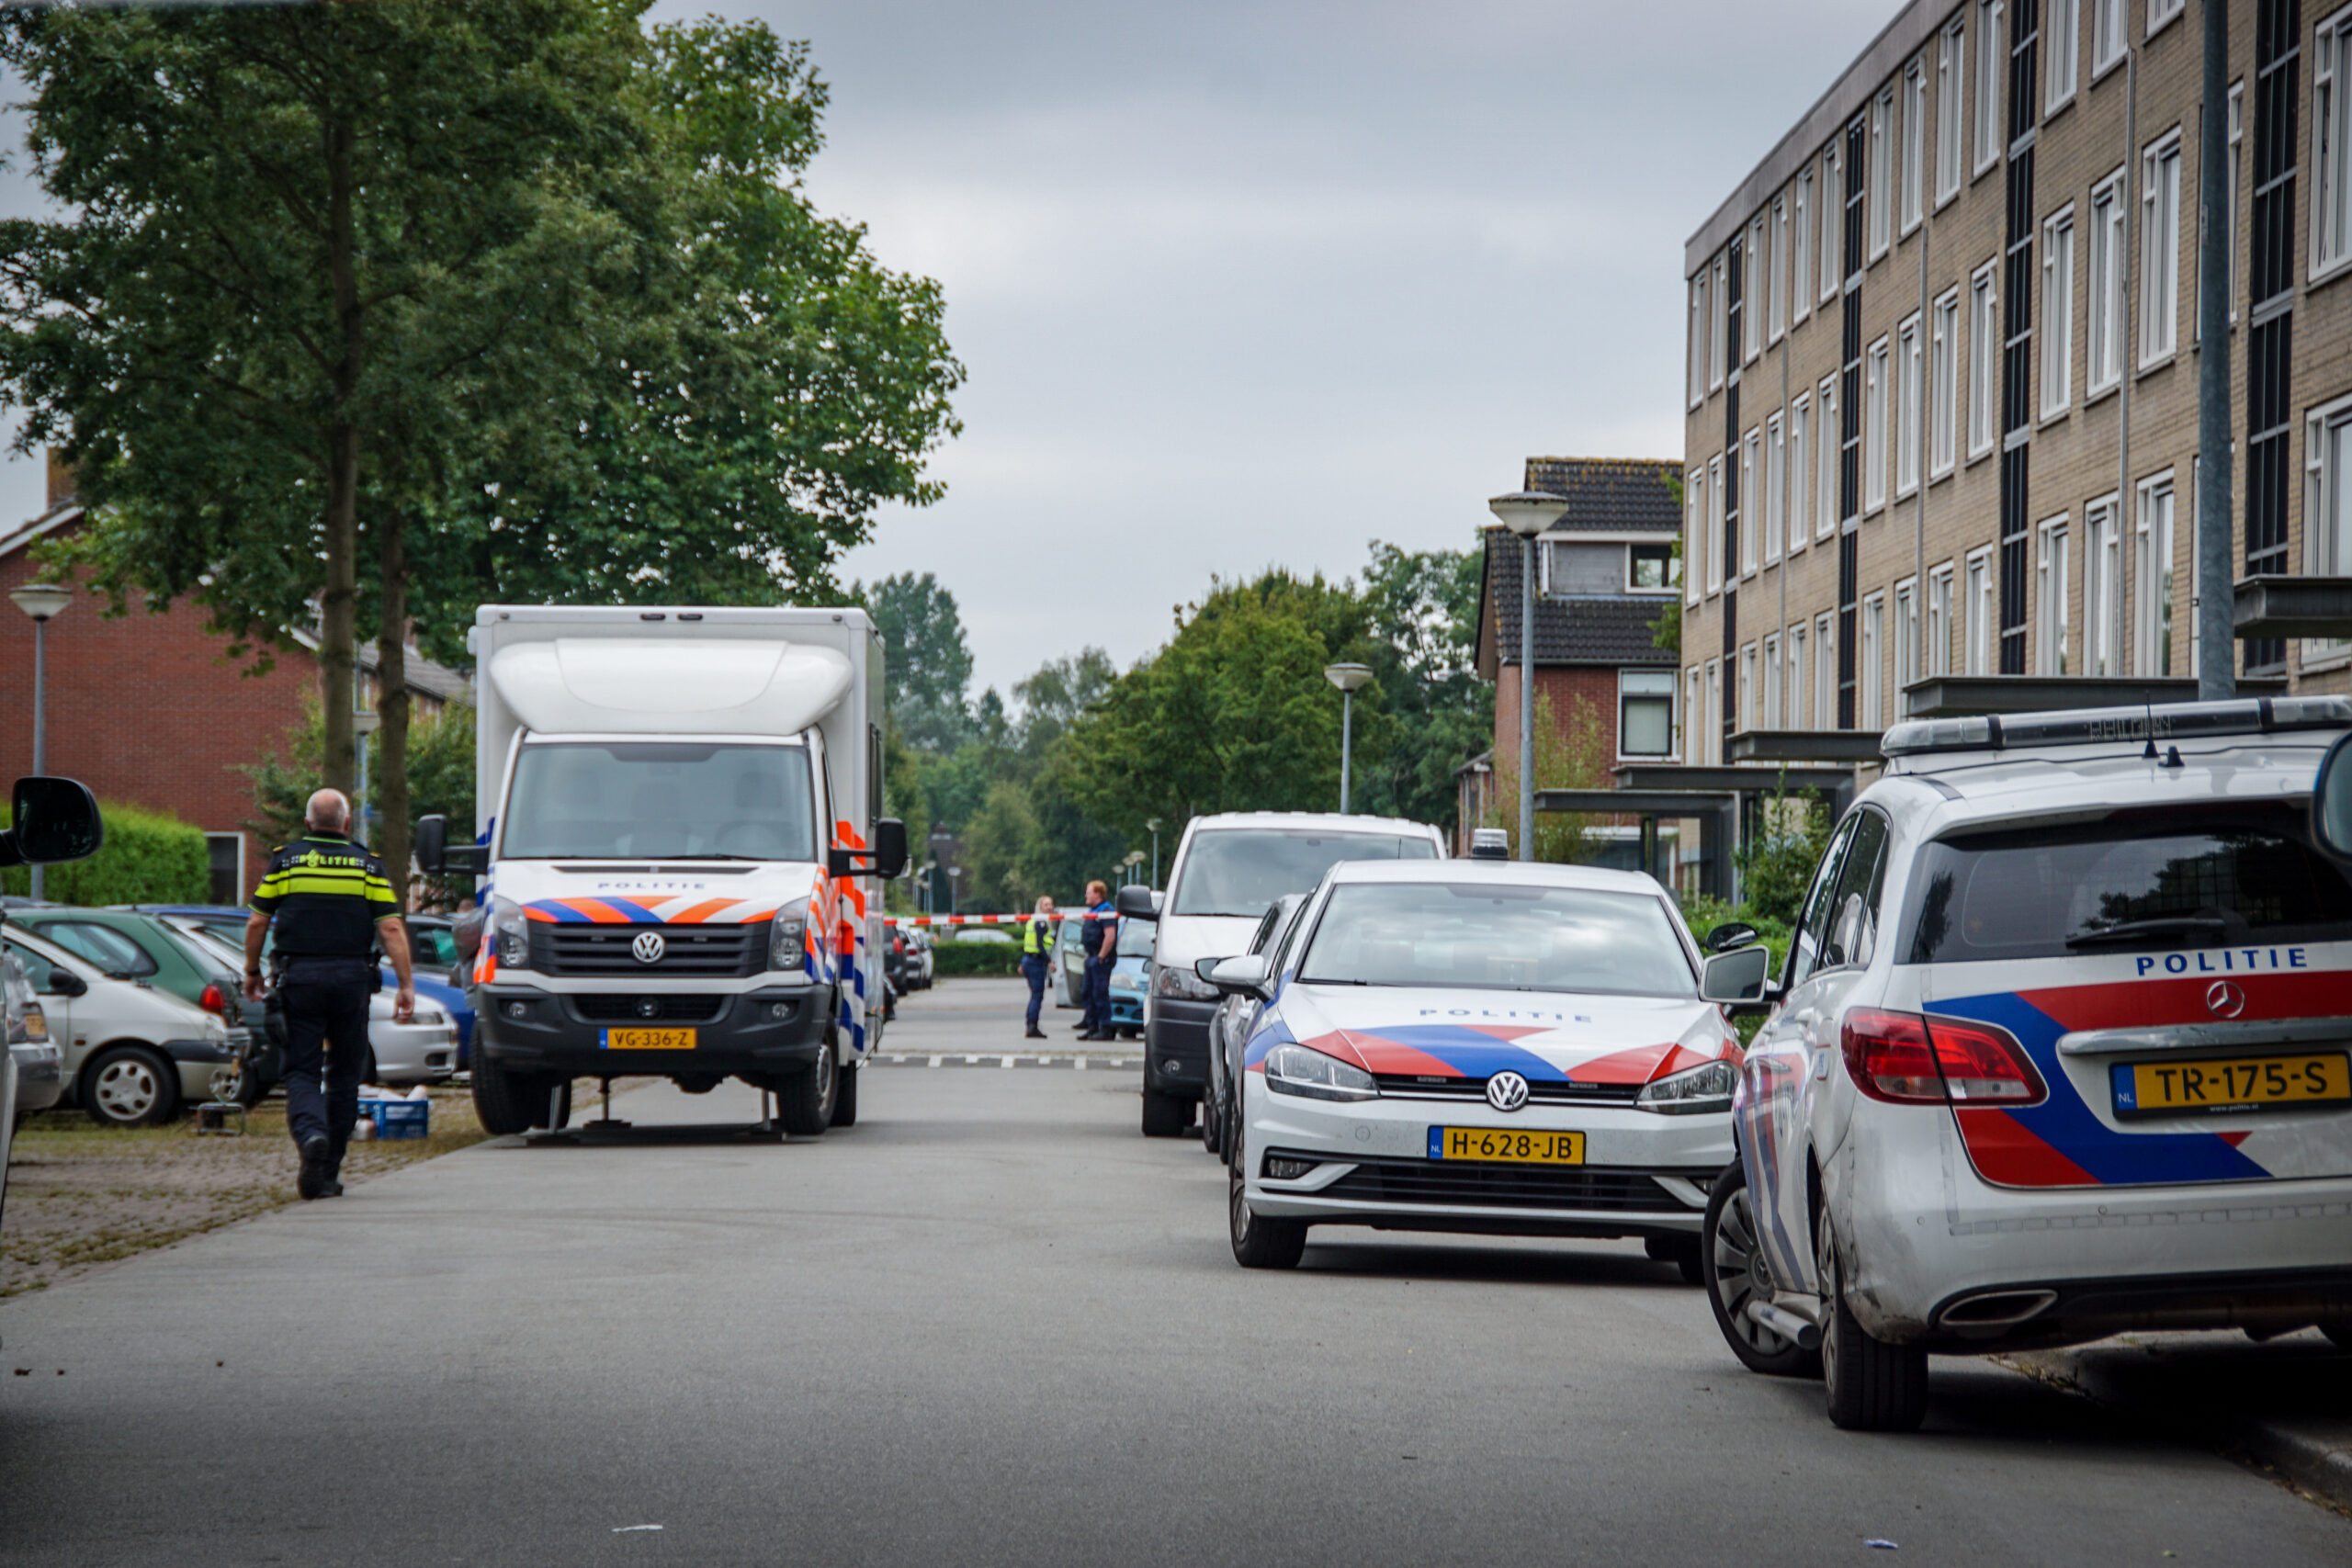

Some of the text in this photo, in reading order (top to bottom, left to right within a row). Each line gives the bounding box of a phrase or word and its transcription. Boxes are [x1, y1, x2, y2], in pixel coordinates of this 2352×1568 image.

[2136, 948, 2307, 976] POLITIE
[1419, 1009, 1591, 1023] POLITIE
[615, 1032, 687, 1046] VG-336-Z
[2118, 1061, 2327, 1103] NL TR-175-S
[1430, 1132, 1572, 1159] NL H-628-JB
